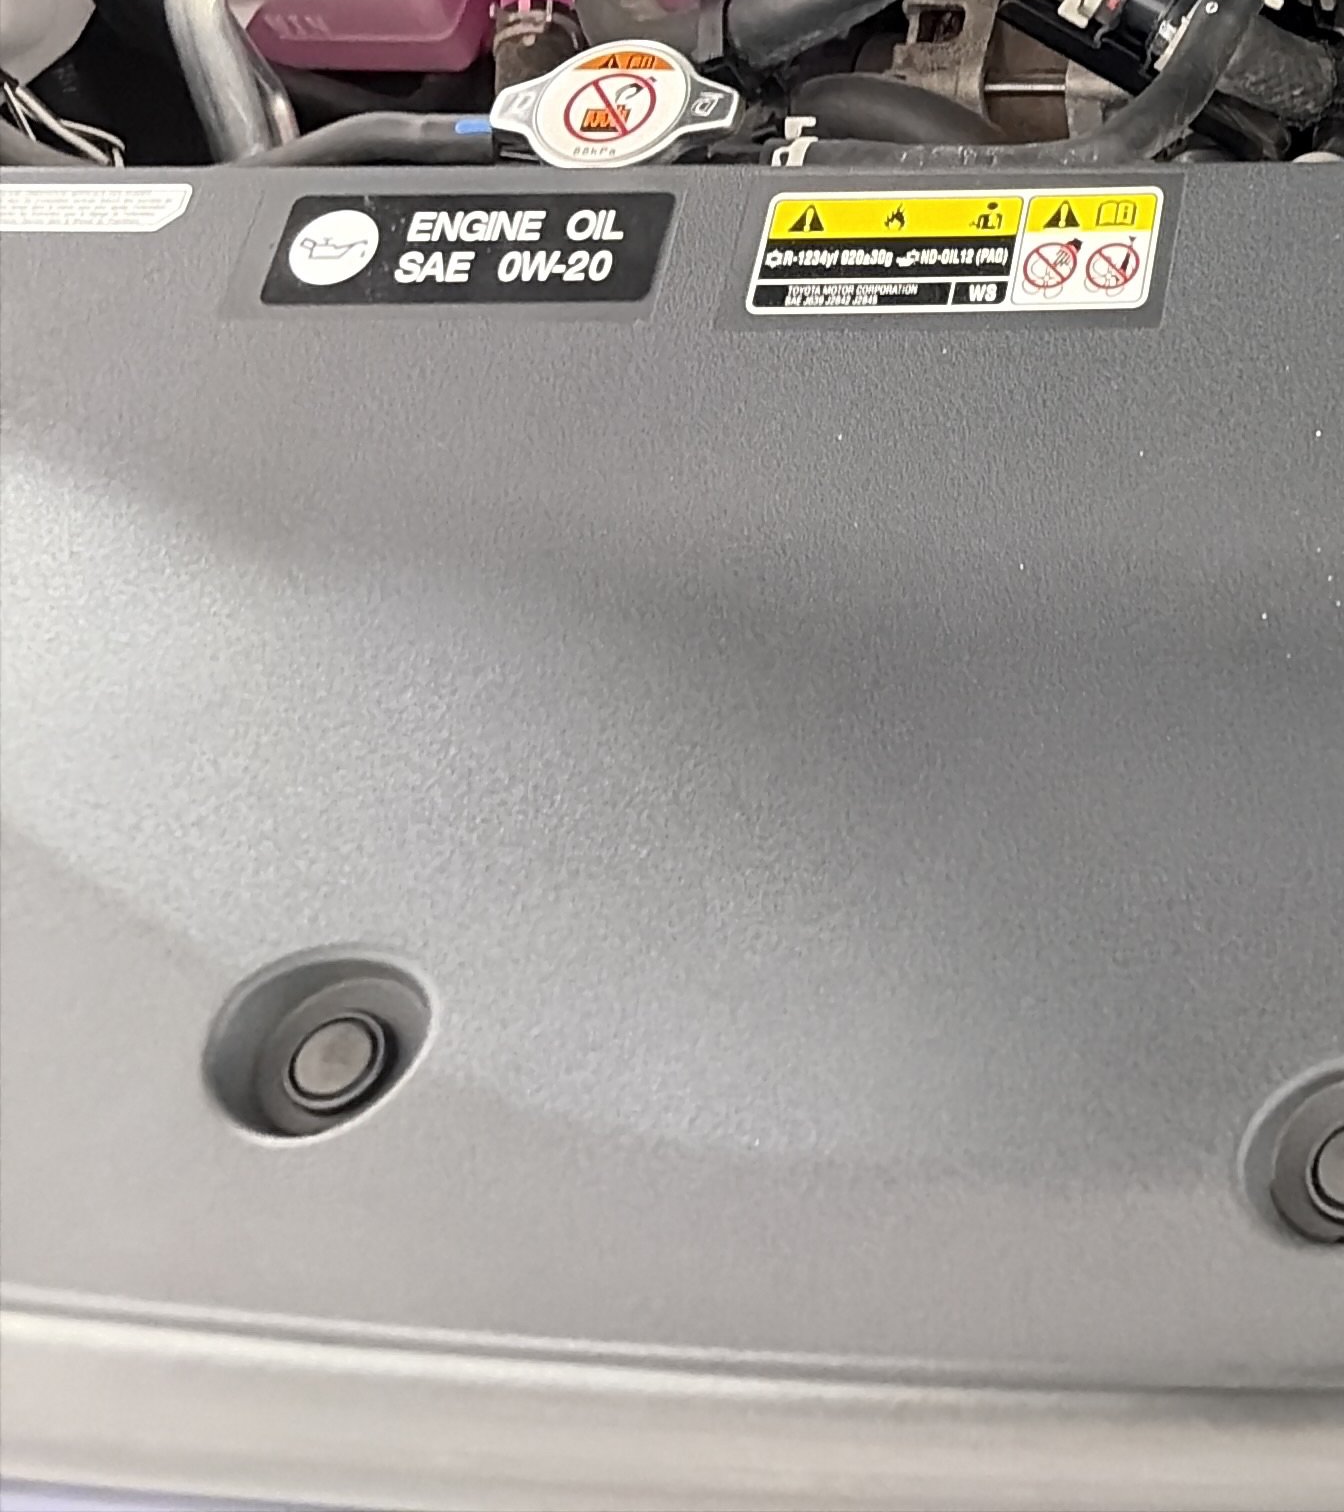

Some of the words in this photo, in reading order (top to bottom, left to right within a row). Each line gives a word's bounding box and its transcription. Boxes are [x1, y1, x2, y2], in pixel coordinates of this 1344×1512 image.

[406, 210, 547, 242] ENGINE
[566, 209, 624, 242] OIL
[394, 251, 475, 284] SAE
[497, 250, 613, 282] 0W-20
[787, 285, 821, 296] TOYOTA
[823, 285, 855, 296] MOTOR
[856, 284, 918, 296] CORPORATION
